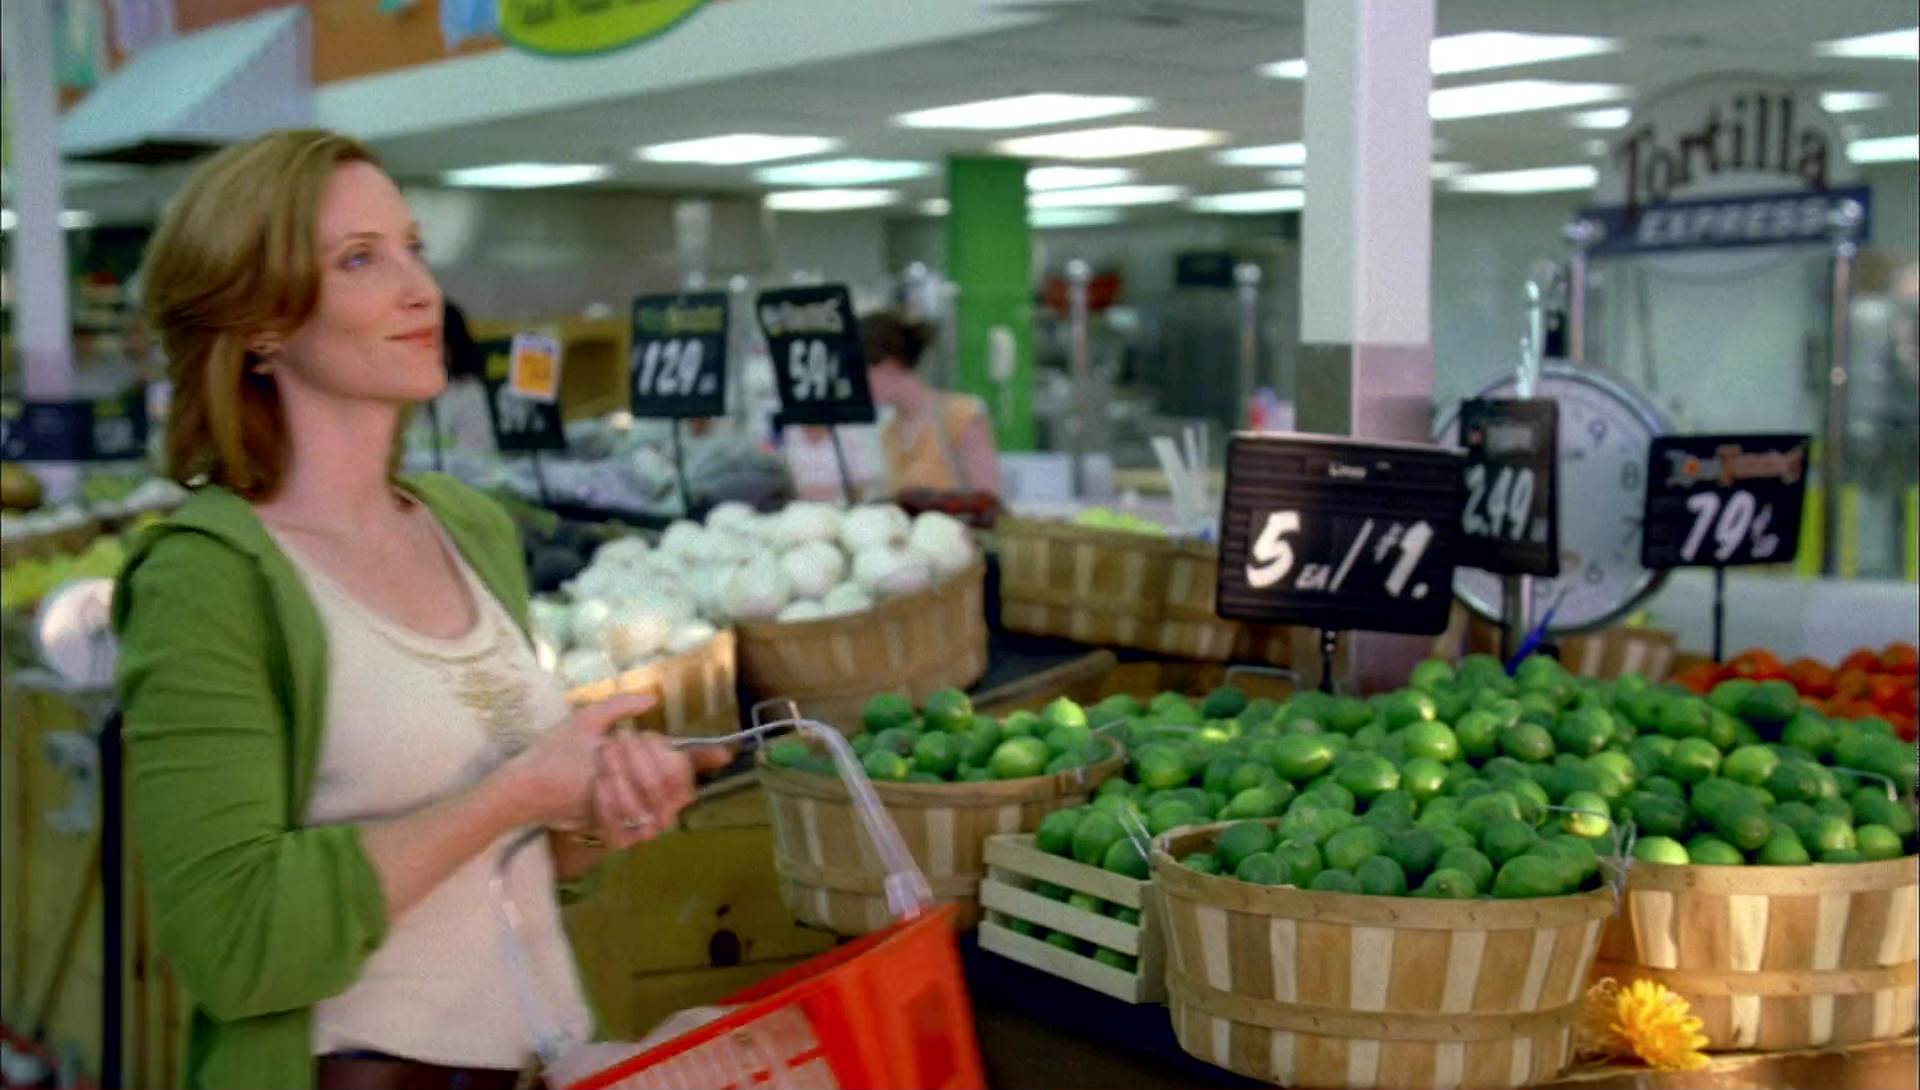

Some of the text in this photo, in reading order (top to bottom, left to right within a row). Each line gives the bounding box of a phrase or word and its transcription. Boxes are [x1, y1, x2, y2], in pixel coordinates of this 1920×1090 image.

[1613, 94, 1827, 222] Tortilla
[1639, 199, 1828, 246] EXPRESS
[1246, 510, 1301, 589] 5
